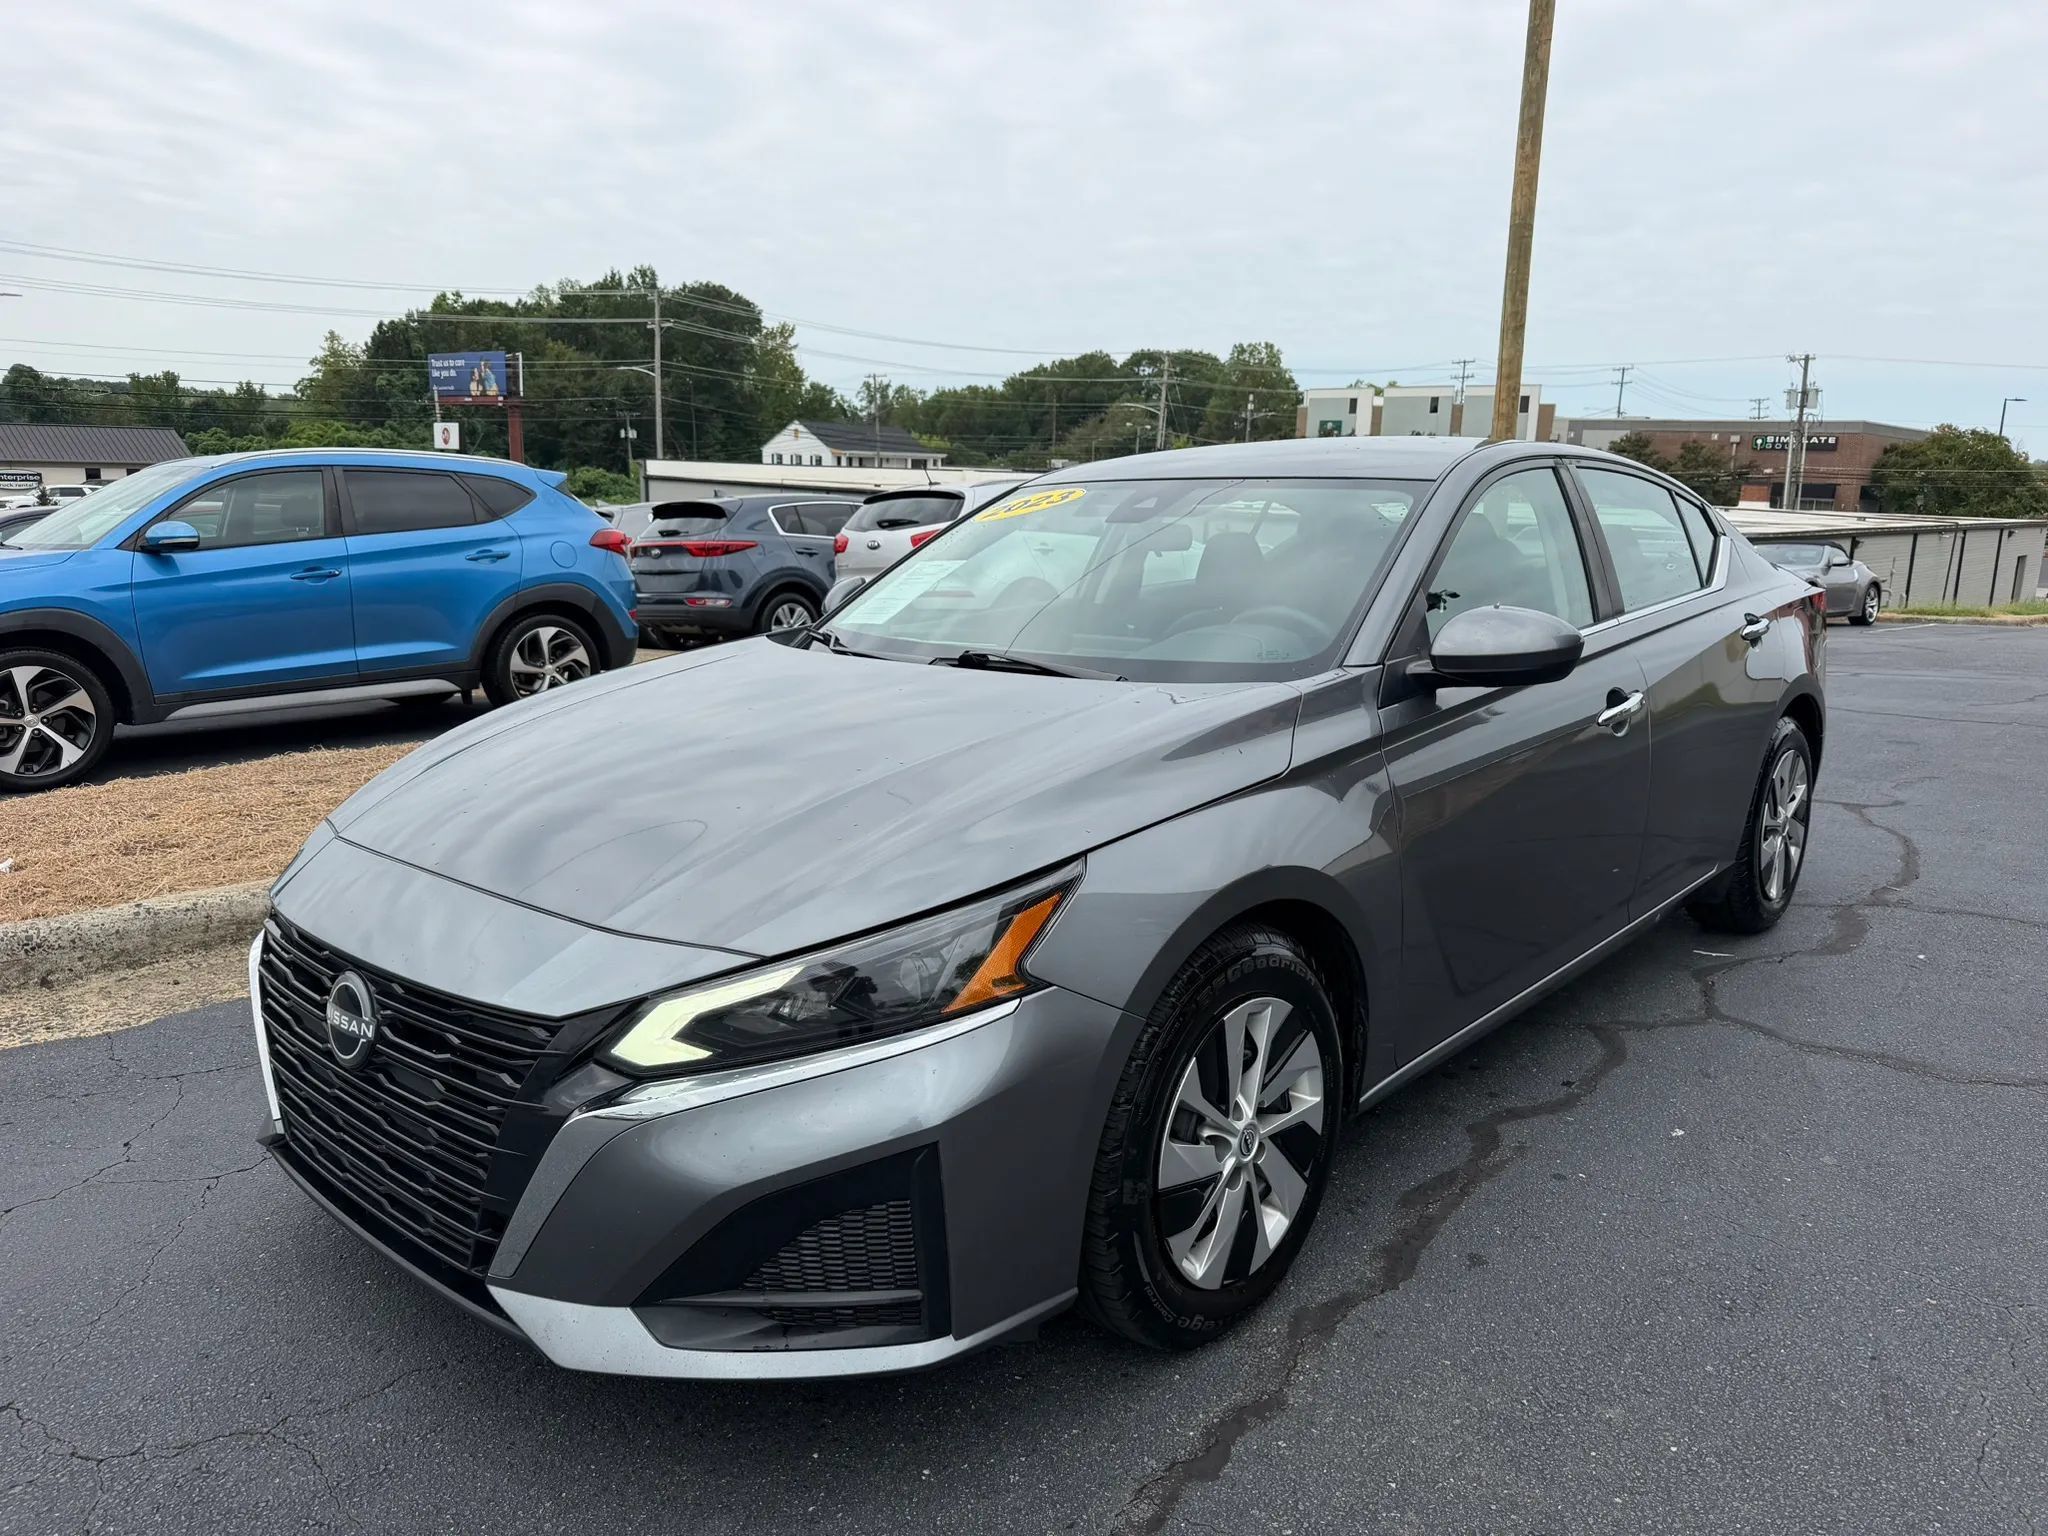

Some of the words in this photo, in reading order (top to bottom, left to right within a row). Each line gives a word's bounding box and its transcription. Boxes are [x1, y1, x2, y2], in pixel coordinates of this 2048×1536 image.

[431, 359, 443, 367] Trust
[443, 359, 449, 367] us
[449, 359, 455, 367] to
[455, 359, 465, 367] care
[440, 369, 449, 379] you
[1766, 435, 1836, 444] SIMLATE
[0, 474, 41, 482] nterprise
[980, 489, 1079, 521] 2023
[326, 1001, 374, 1038] NISSAN
